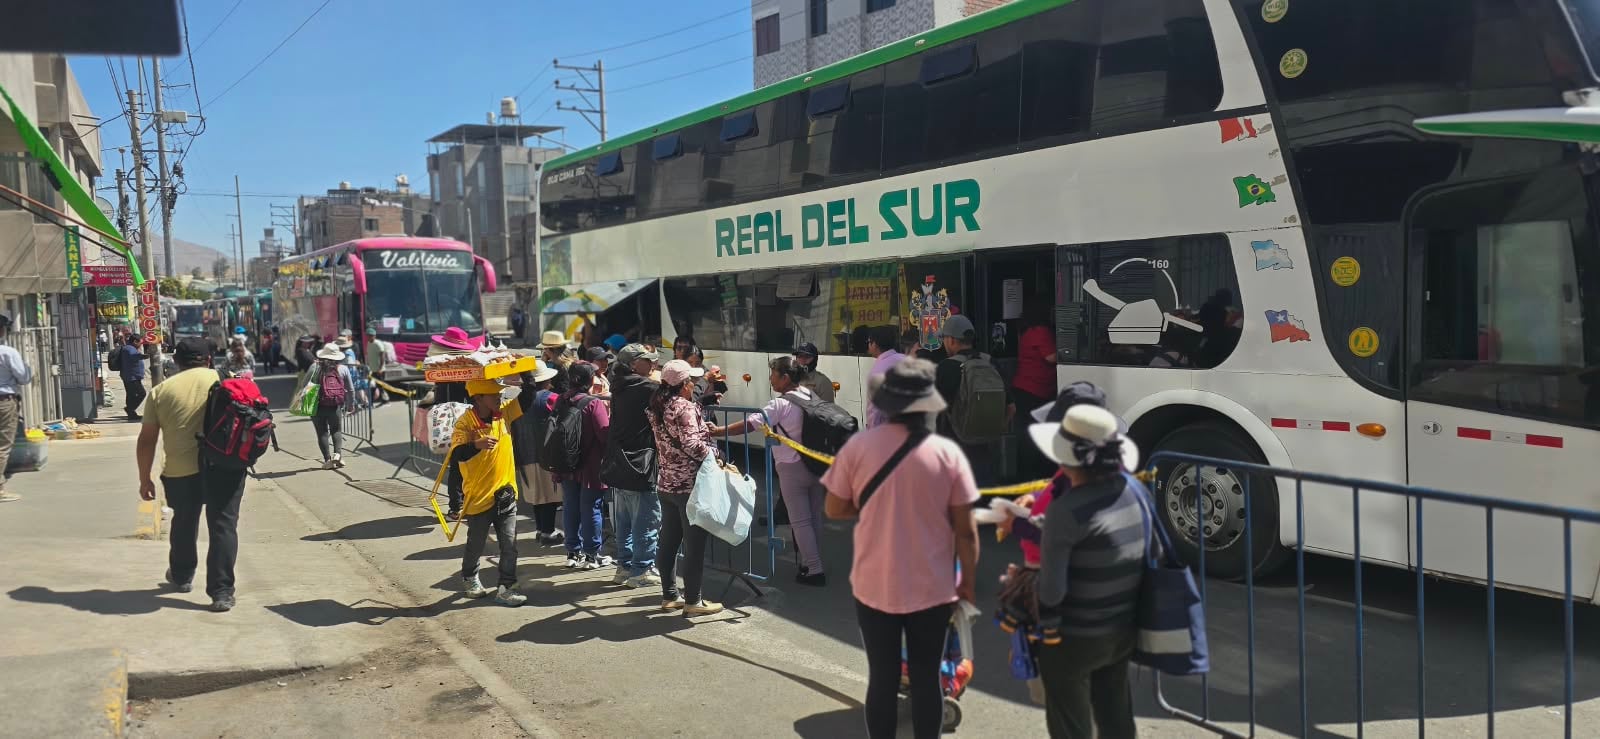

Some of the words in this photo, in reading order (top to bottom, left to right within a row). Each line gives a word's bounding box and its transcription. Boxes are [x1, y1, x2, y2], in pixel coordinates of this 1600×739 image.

[715, 209, 793, 257] REAL
[801, 197, 869, 249] DEL
[878, 178, 981, 241] SUR
[380, 250, 460, 268] Valdivia
[1151, 259, 1168, 268] 160
[141, 281, 157, 343] JUGOS
